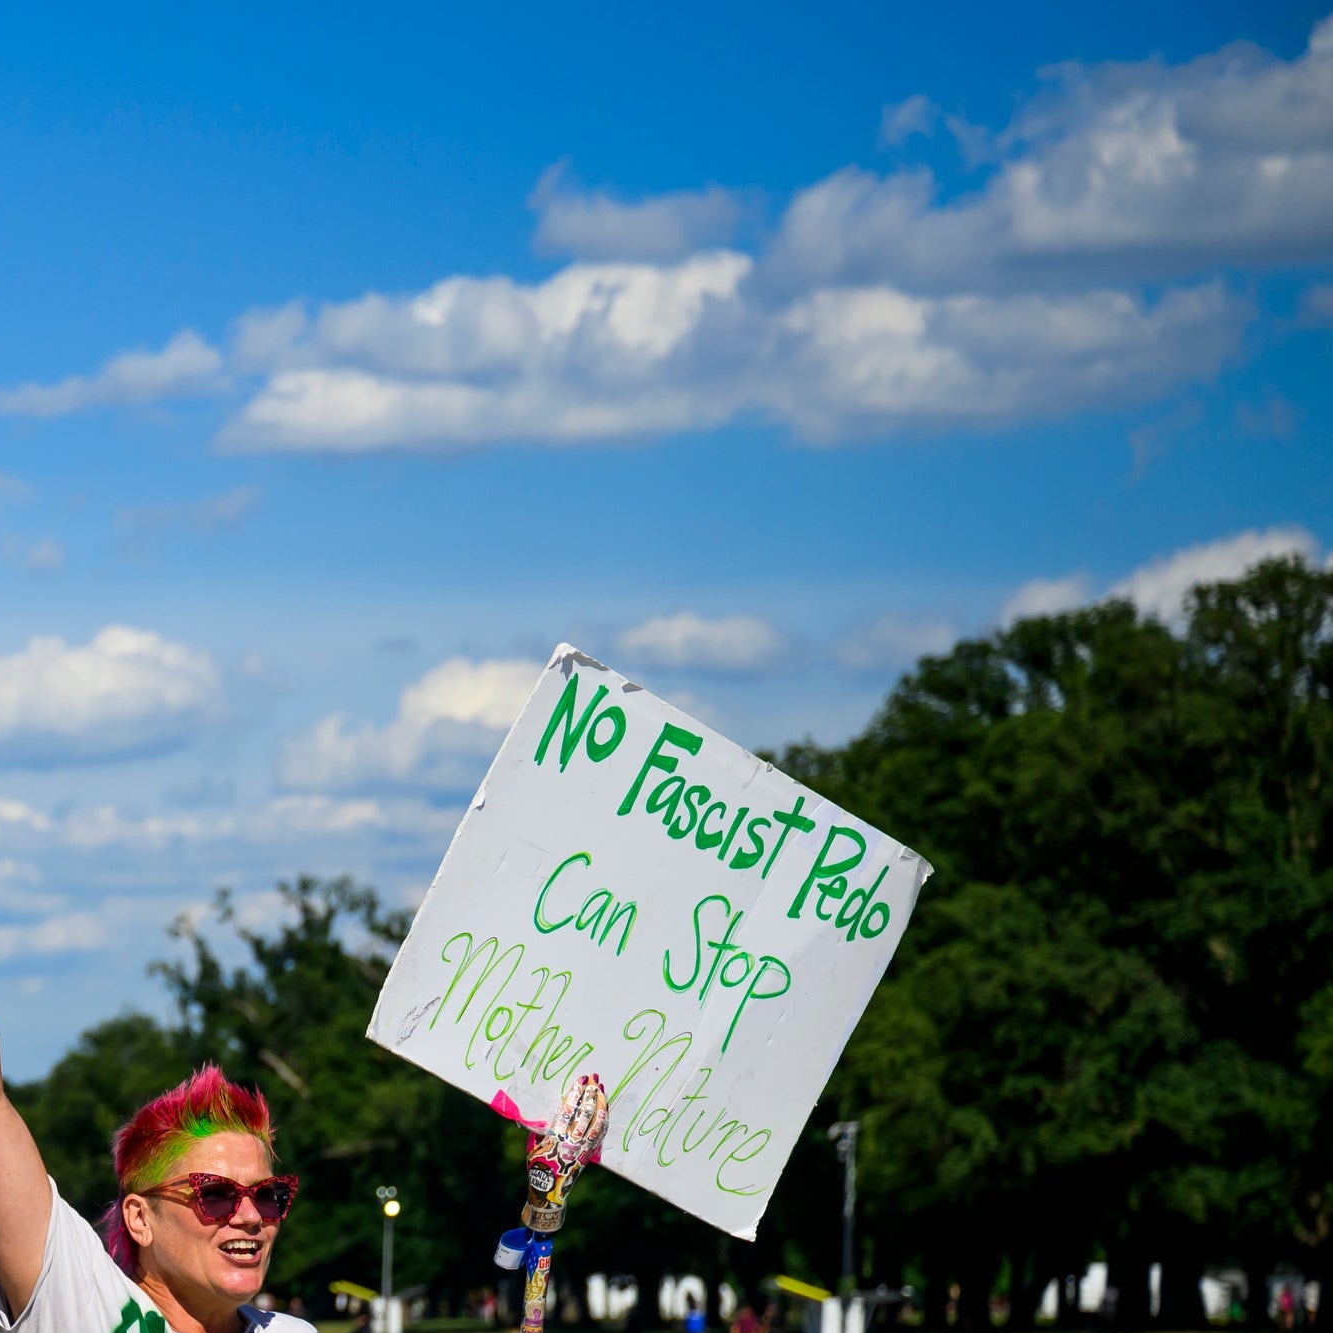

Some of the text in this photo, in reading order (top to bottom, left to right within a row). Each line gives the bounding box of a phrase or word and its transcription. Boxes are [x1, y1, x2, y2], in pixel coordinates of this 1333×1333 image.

[534, 672, 890, 941] No Fascist Pedo
[429, 932, 772, 1196] Mother Nature
[533, 851, 791, 1063] Can Stop
